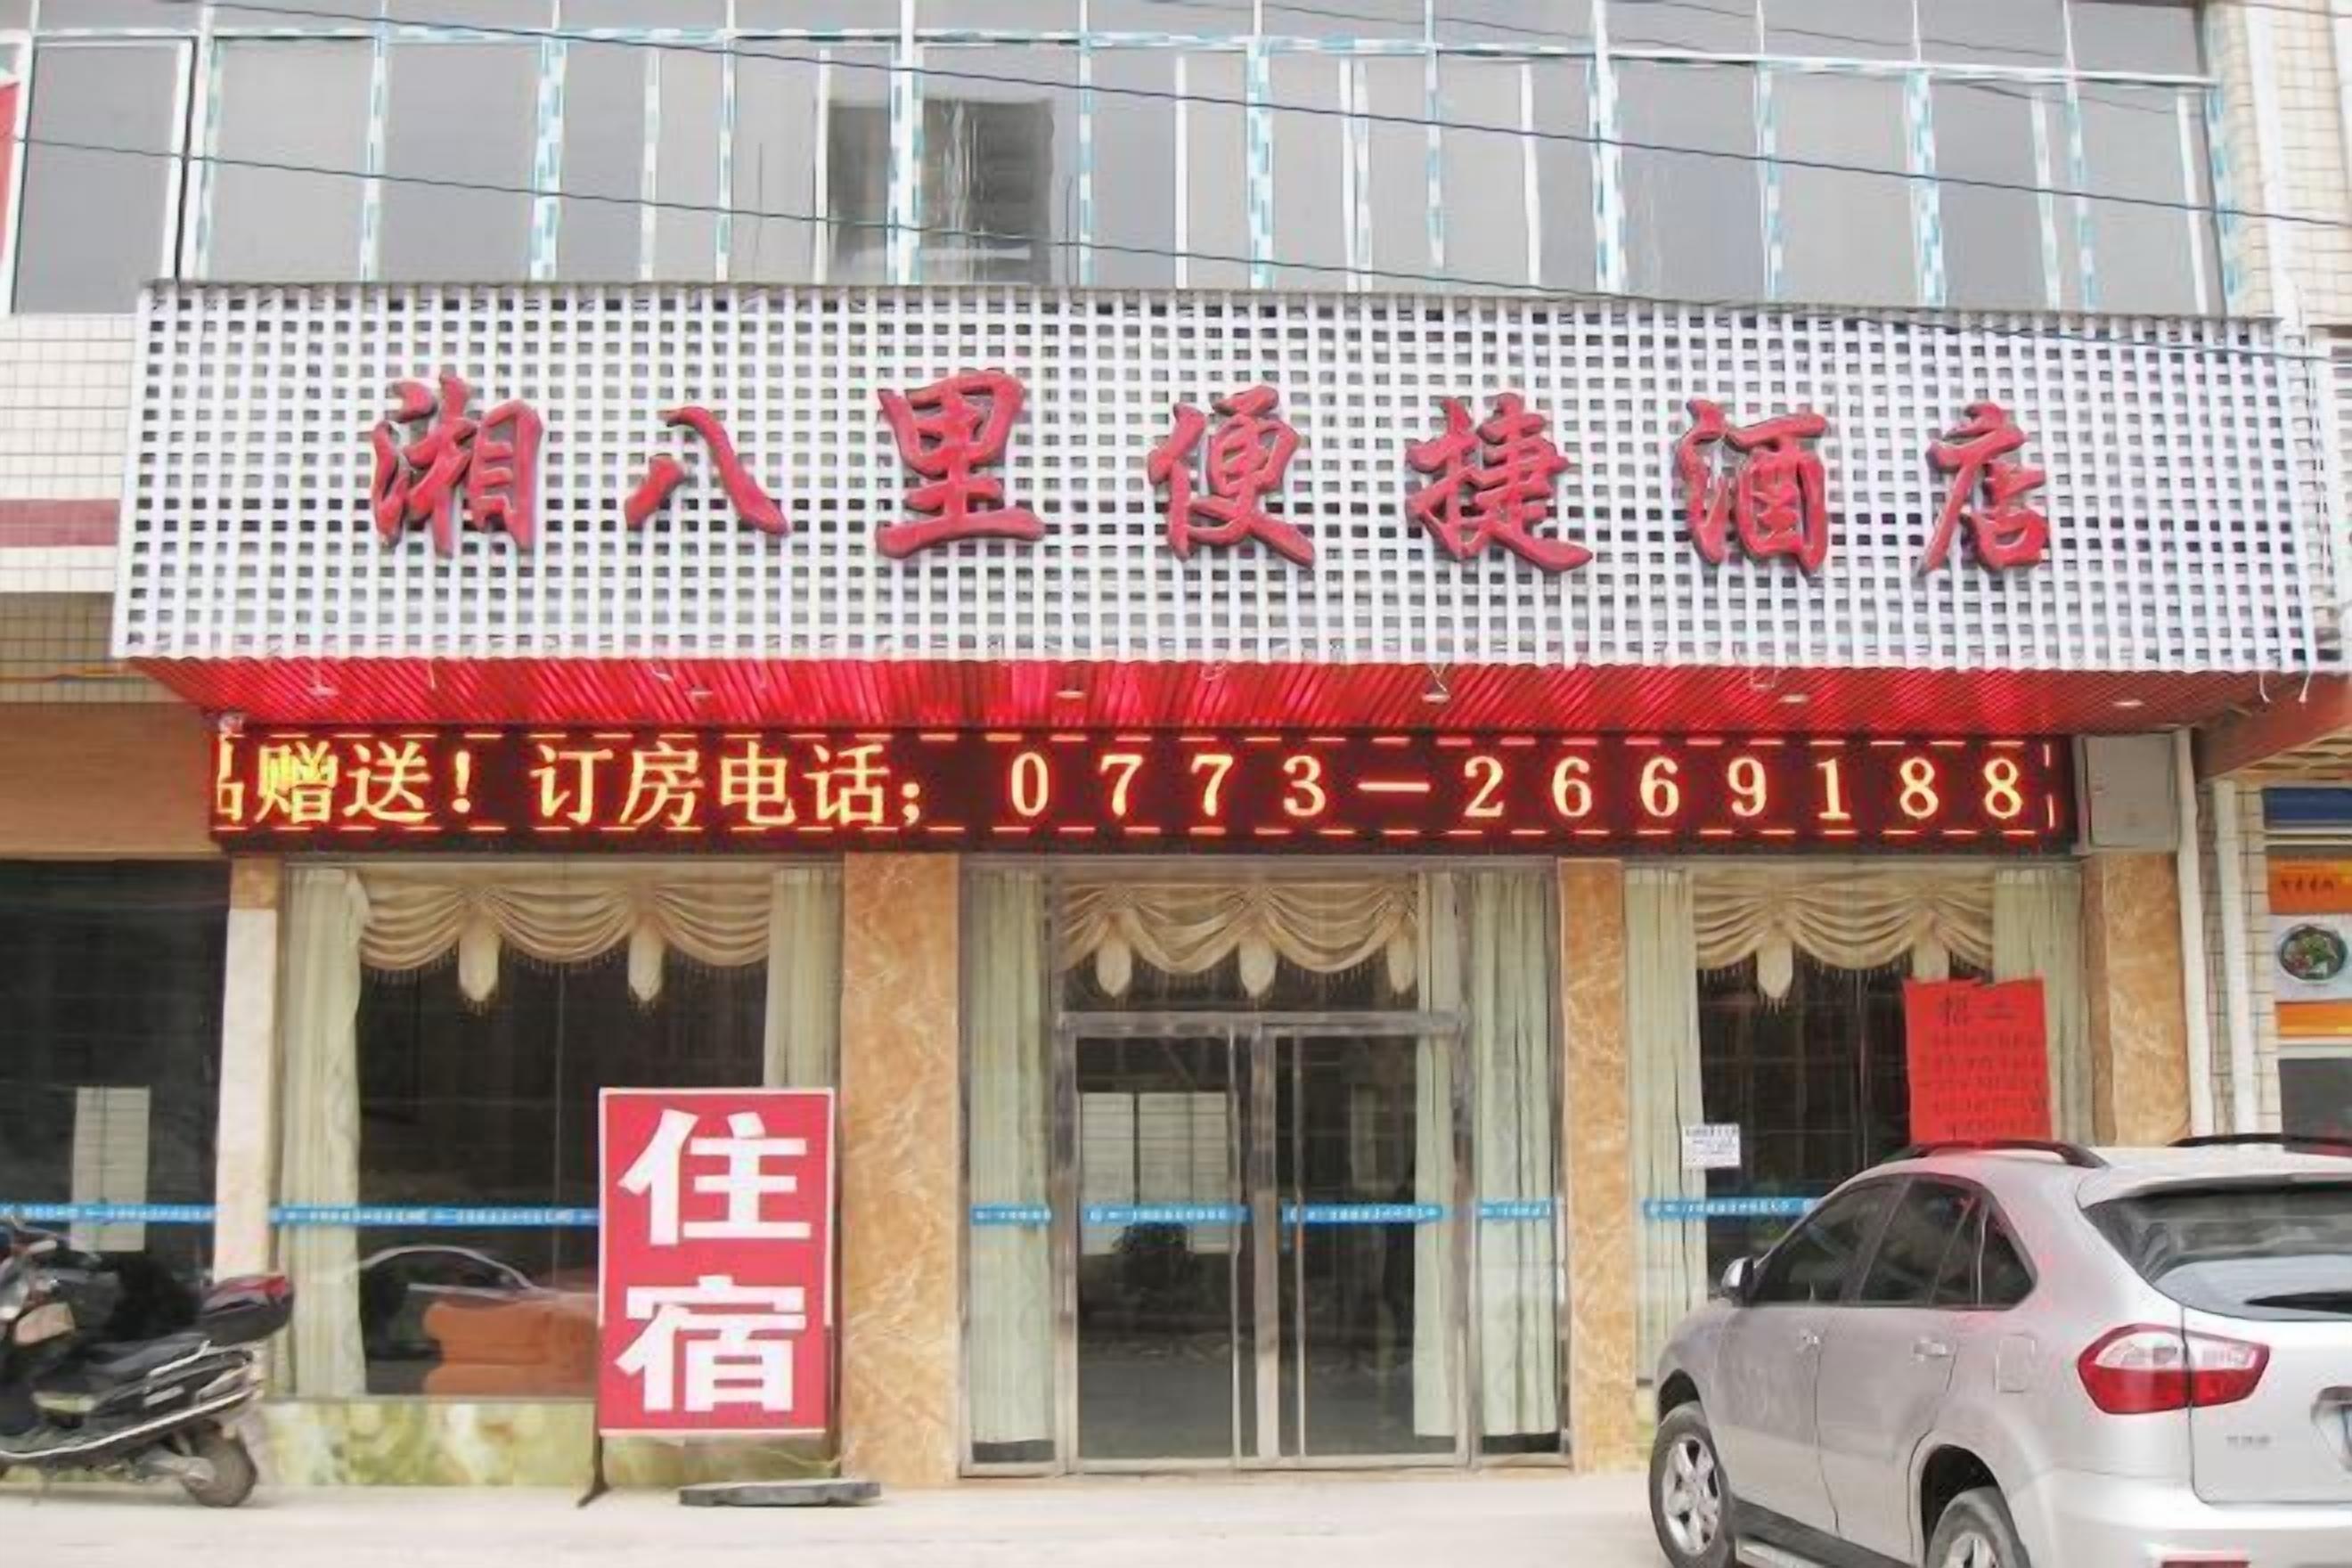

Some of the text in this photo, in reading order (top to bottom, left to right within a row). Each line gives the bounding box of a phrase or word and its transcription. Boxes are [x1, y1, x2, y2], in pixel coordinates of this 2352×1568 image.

[371, 367, 2053, 578] 湘八里便捷酒店
[614, 1107, 812, 1414] 住宿
